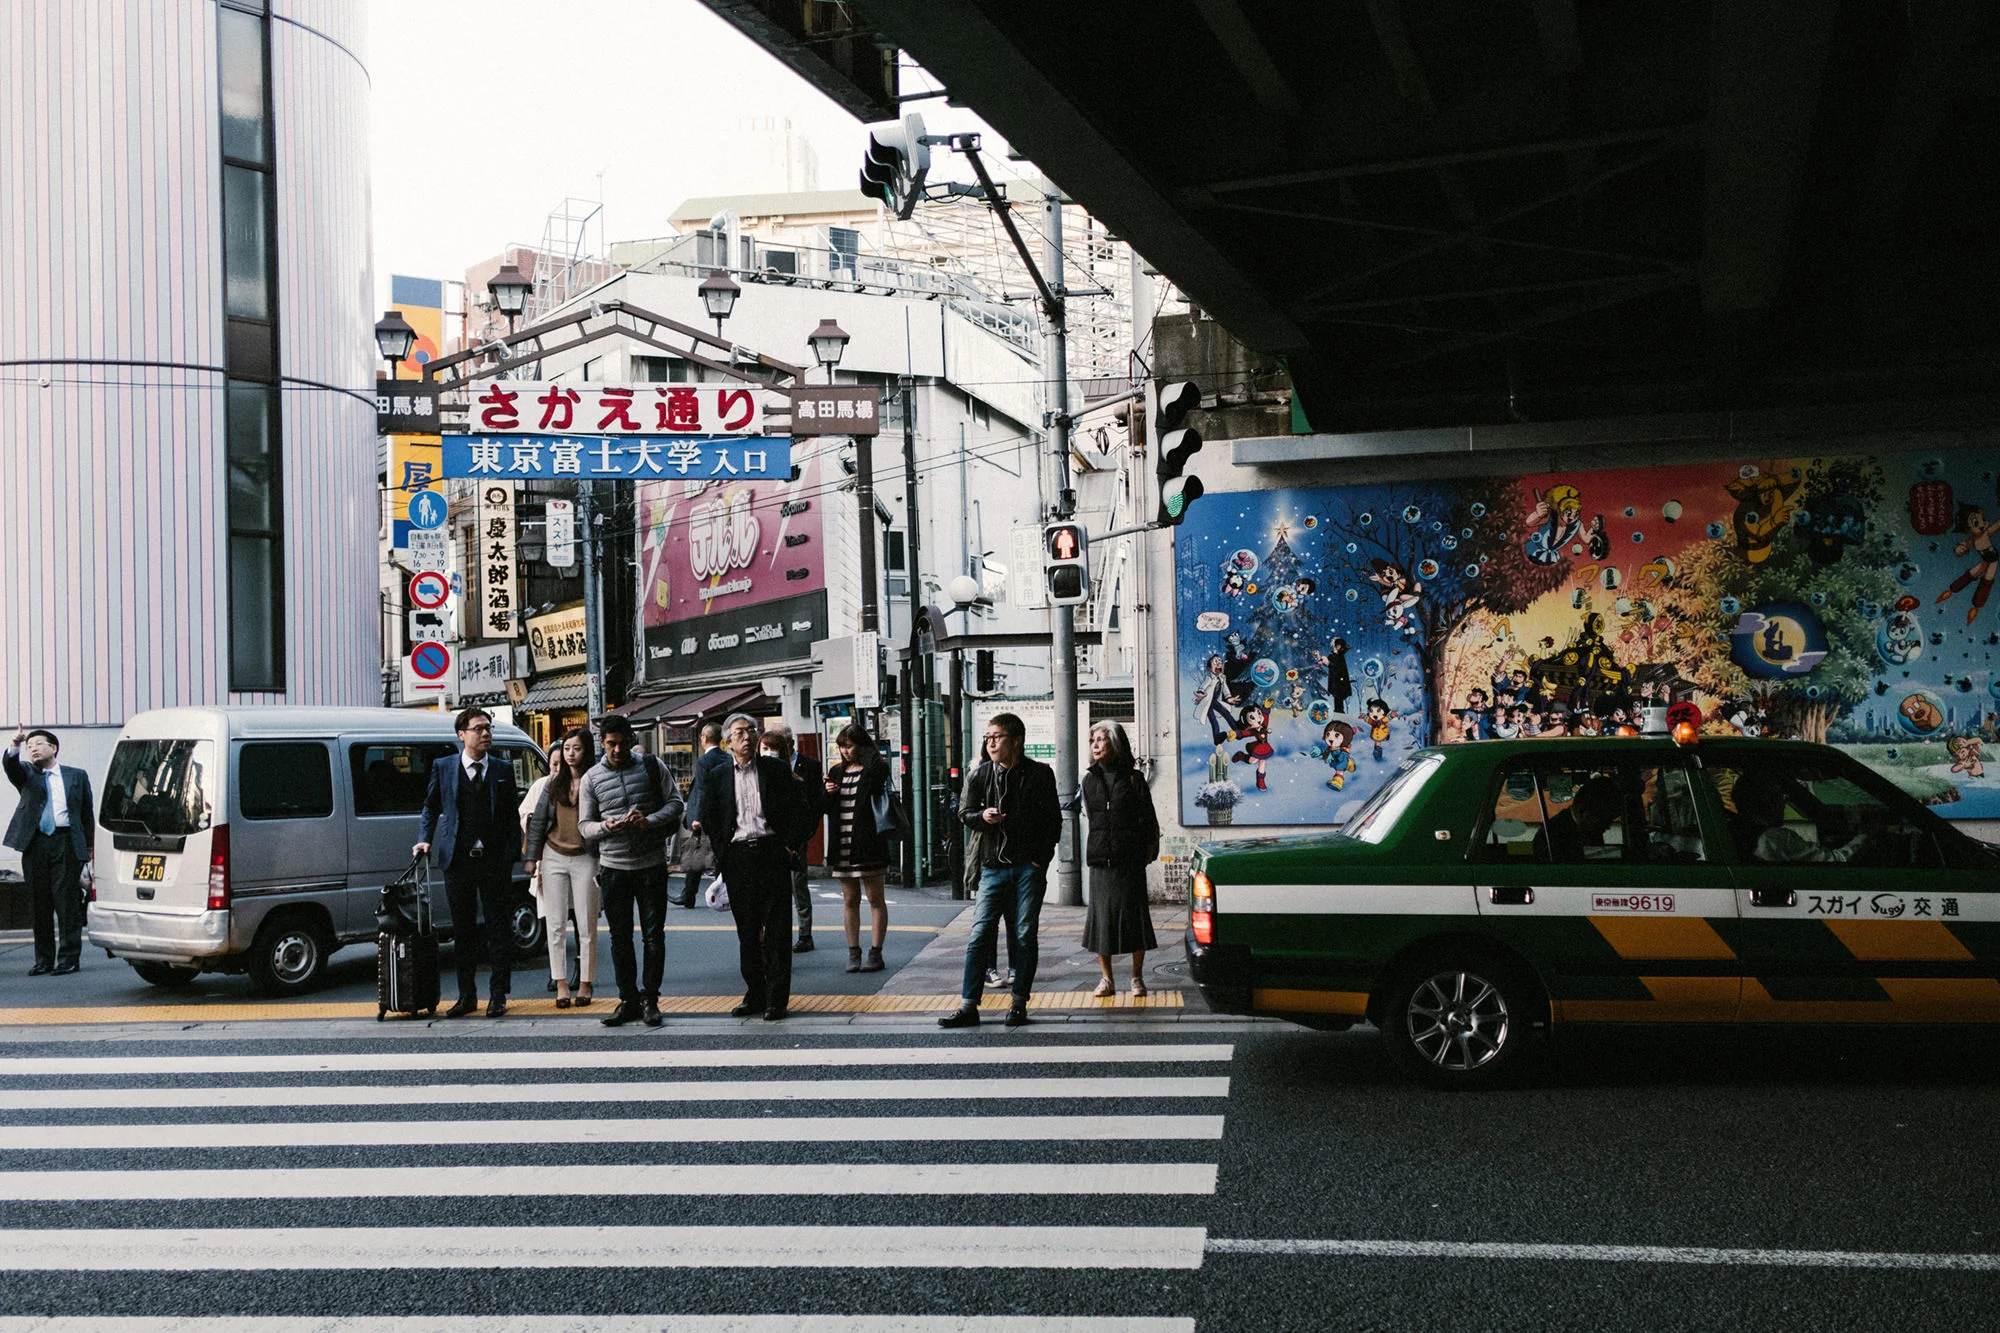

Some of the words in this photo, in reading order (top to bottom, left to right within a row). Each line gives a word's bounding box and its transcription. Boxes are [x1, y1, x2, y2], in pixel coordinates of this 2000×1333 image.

[478, 383, 755, 431] さかえ通り
[798, 400, 874, 419] 高田馬場
[467, 437, 702, 475] 東京富士大学
[710, 447, 768, 476] 入口
[439, 550, 445, 558] 9
[430, 630, 436, 638] 4
[440, 630, 445, 638] t
[1629, 895, 1673, 911] 9619
[1808, 895, 1862, 915] スガイ
[1913, 897, 1960, 917] 交通
